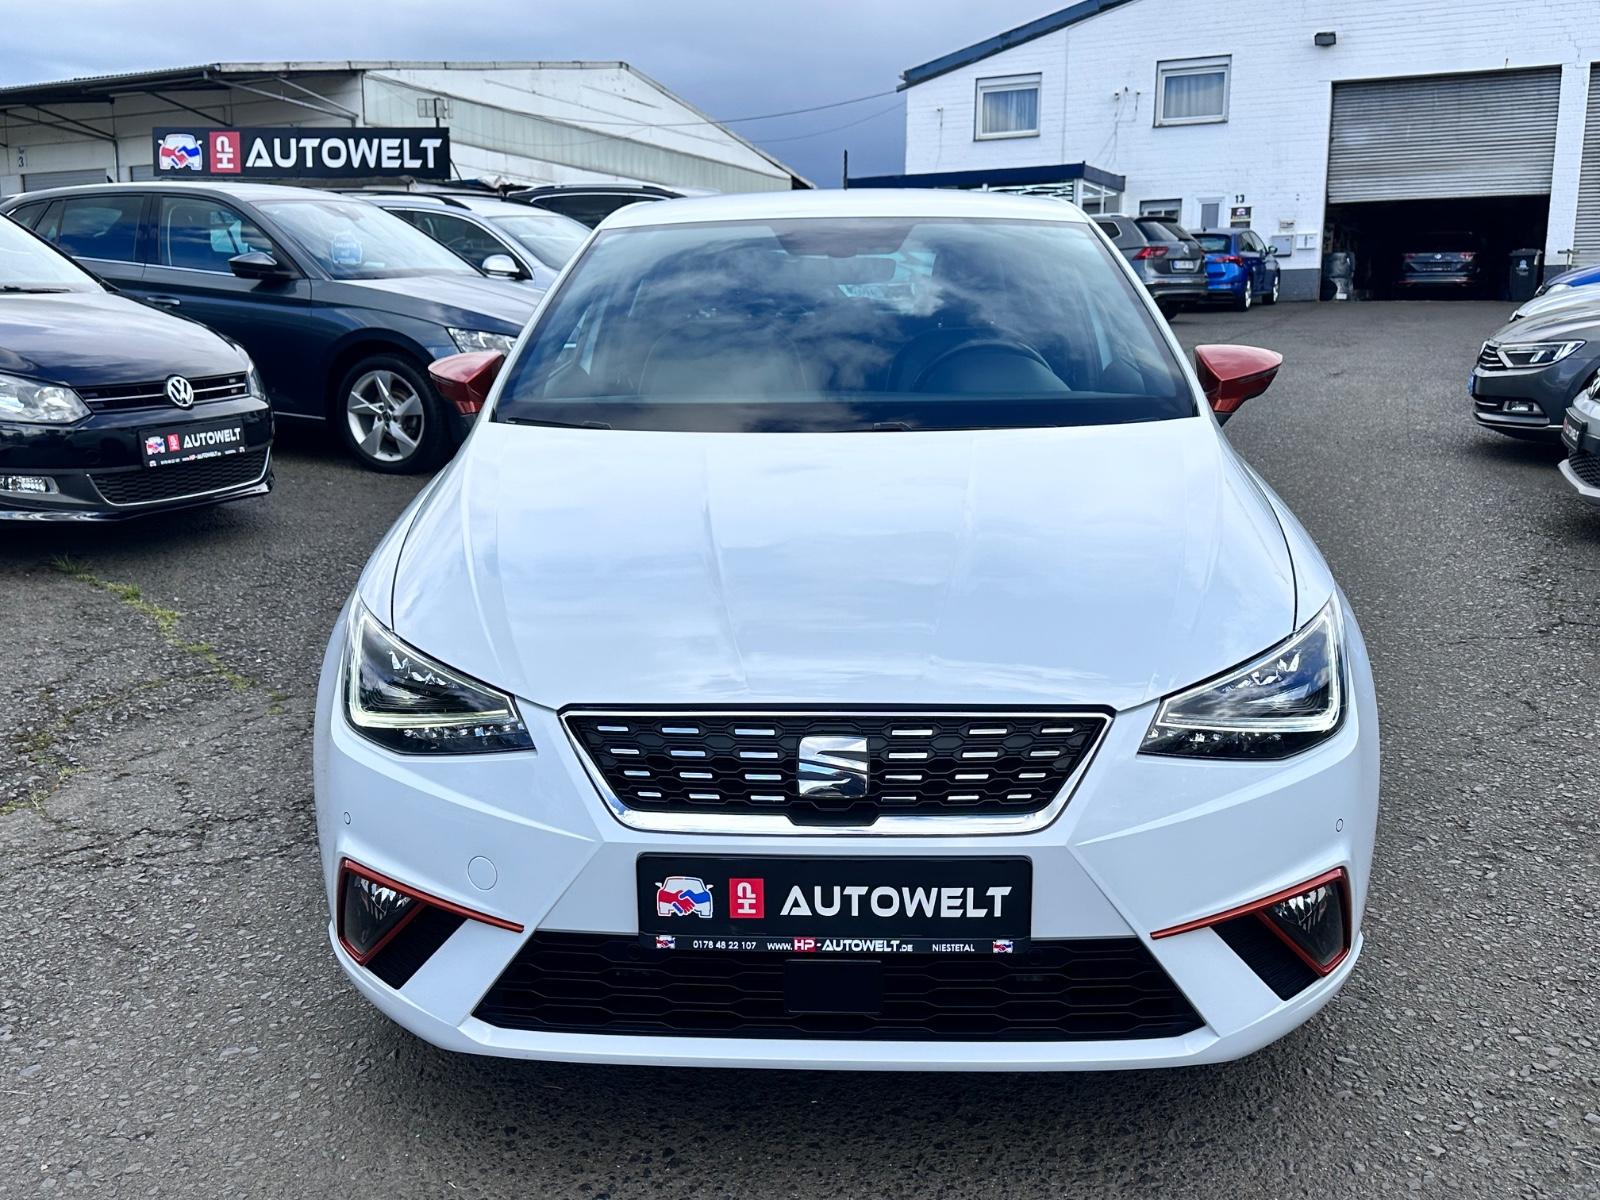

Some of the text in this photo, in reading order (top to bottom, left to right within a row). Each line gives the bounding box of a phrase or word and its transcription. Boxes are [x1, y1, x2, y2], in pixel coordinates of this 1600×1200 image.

[246, 138, 442, 169] AUTOWELT
[1235, 194, 1245, 204] 13
[183, 427, 241, 448] AUTOWELT
[736, 881, 1011, 918] HP AUTOWELT
[692, 940, 714, 949] 0178
[715, 941, 726, 950] 48
[728, 941, 739, 950] 22
[742, 942, 756, 950] 107
[931, 944, 975, 953] NIESTETAL
